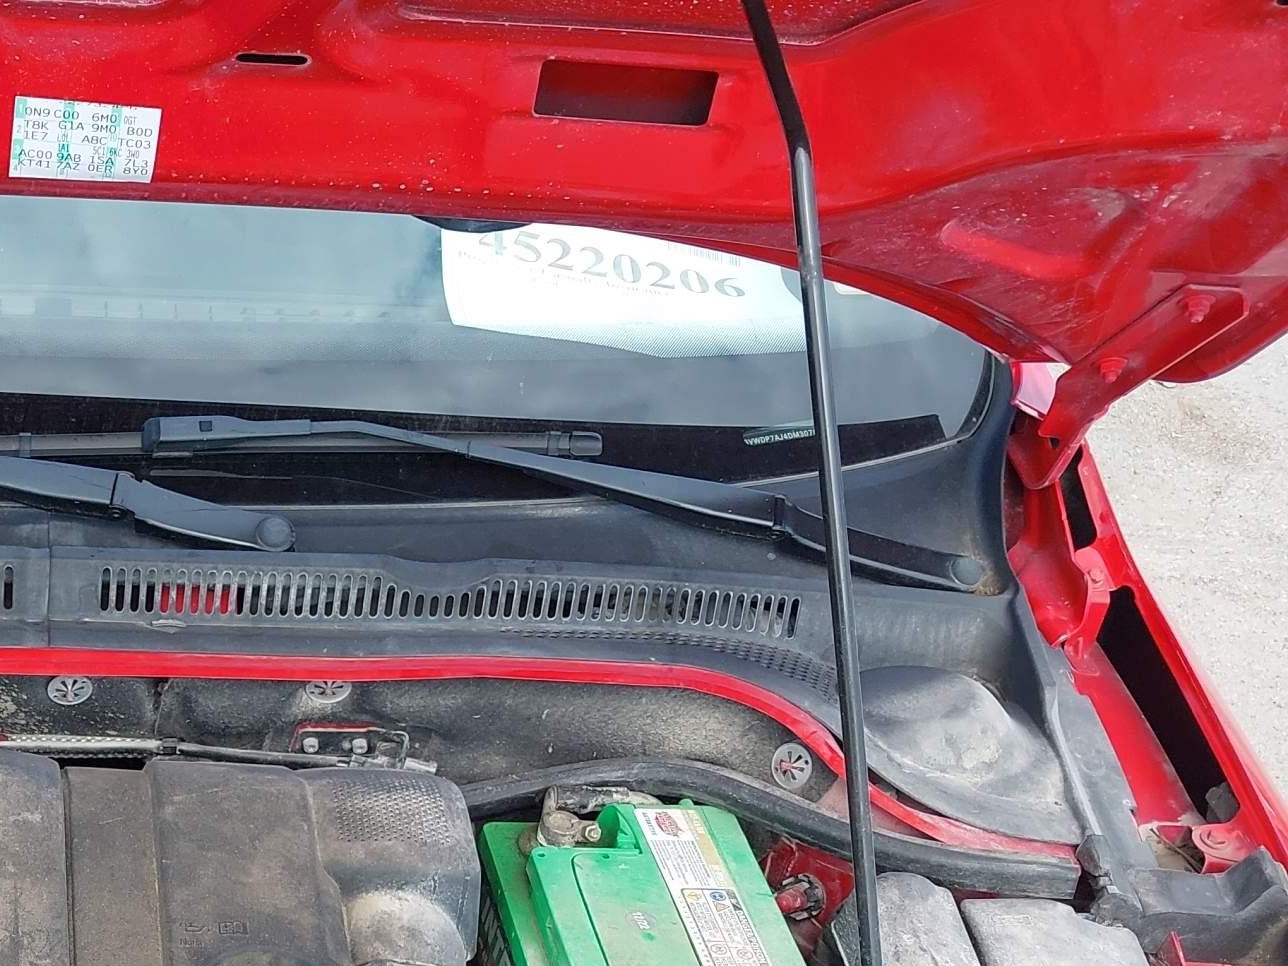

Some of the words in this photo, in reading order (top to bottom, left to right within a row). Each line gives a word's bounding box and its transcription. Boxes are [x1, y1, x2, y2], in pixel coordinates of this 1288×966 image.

[24, 119, 49, 130] T8K
[81, 135, 107, 145] A8C
[56, 152, 81, 162] 9AB
[124, 158, 148, 167] 7L3
